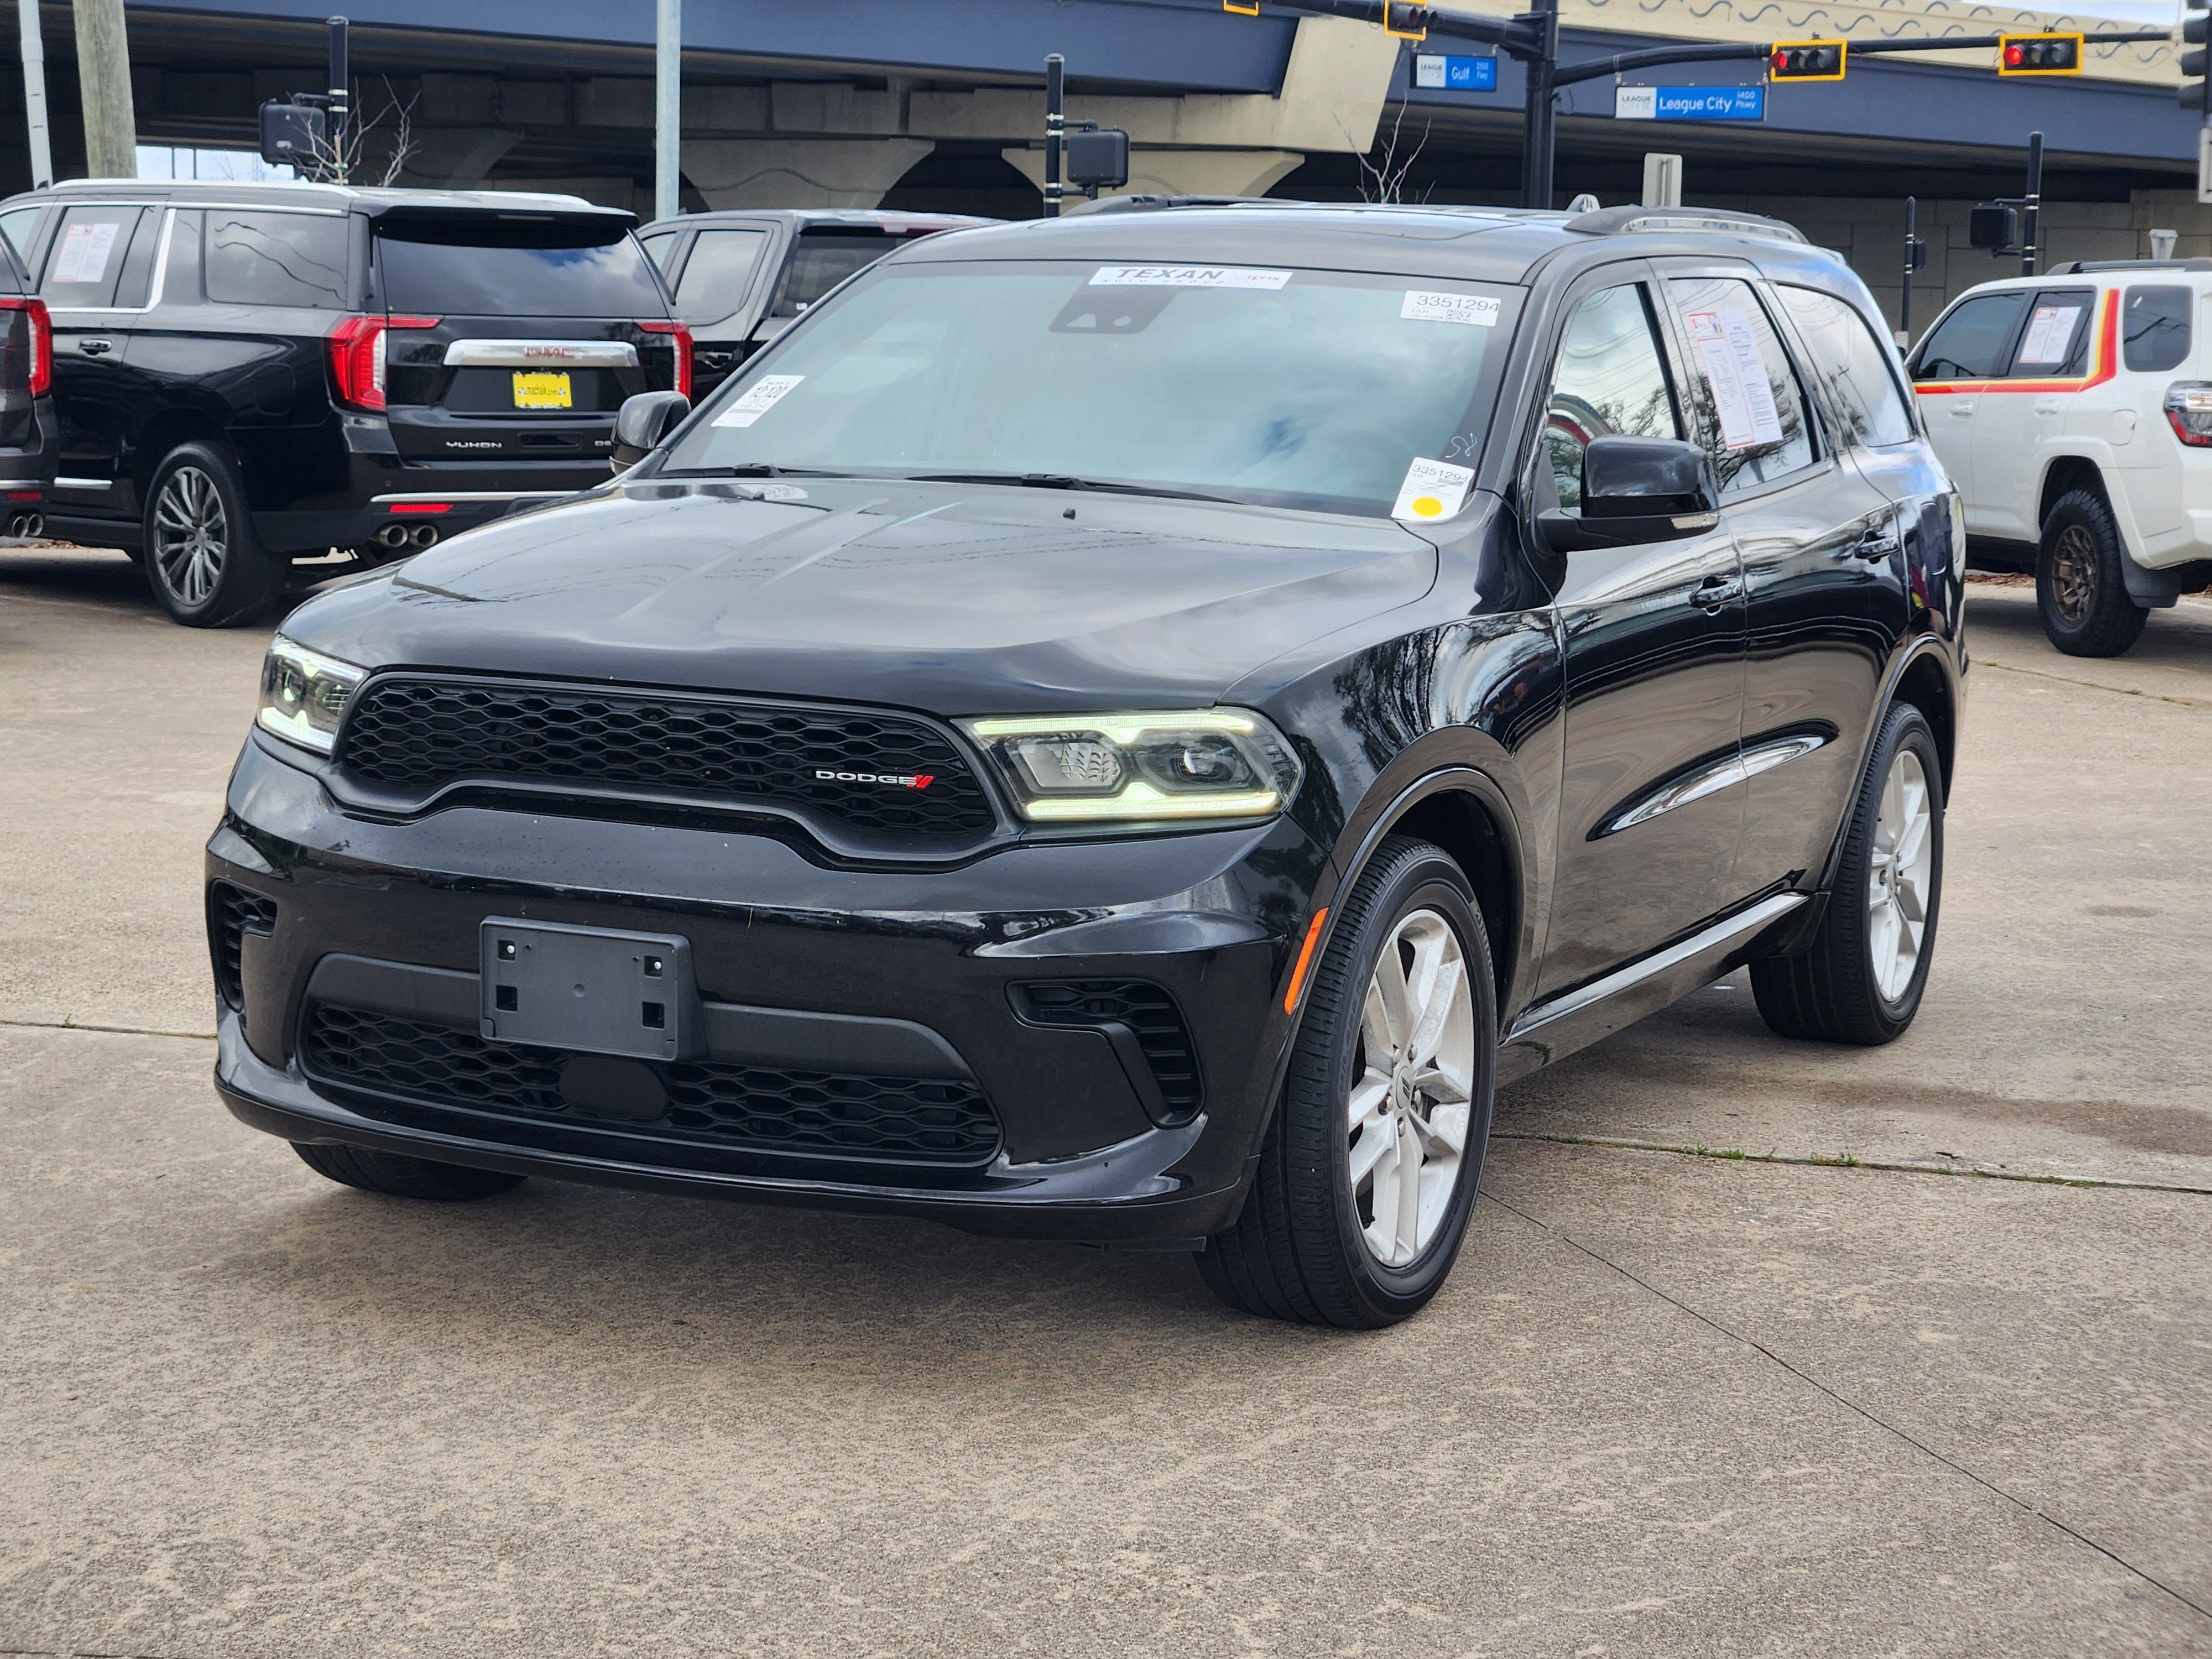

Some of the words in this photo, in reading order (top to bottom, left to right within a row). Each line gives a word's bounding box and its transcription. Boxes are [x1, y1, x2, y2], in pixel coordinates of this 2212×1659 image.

[1451, 65, 1470, 81] Gulf
[1736, 90, 1756, 99] 1400
[1659, 96, 1704, 114] League
[1706, 96, 1733, 113] City
[1117, 268, 1226, 279] TEXAN
[1416, 295, 1500, 312] 3351294
[525, 347, 575, 358] GMC
[446, 441, 503, 449] YUKON
[815, 770, 917, 785] DODGE
